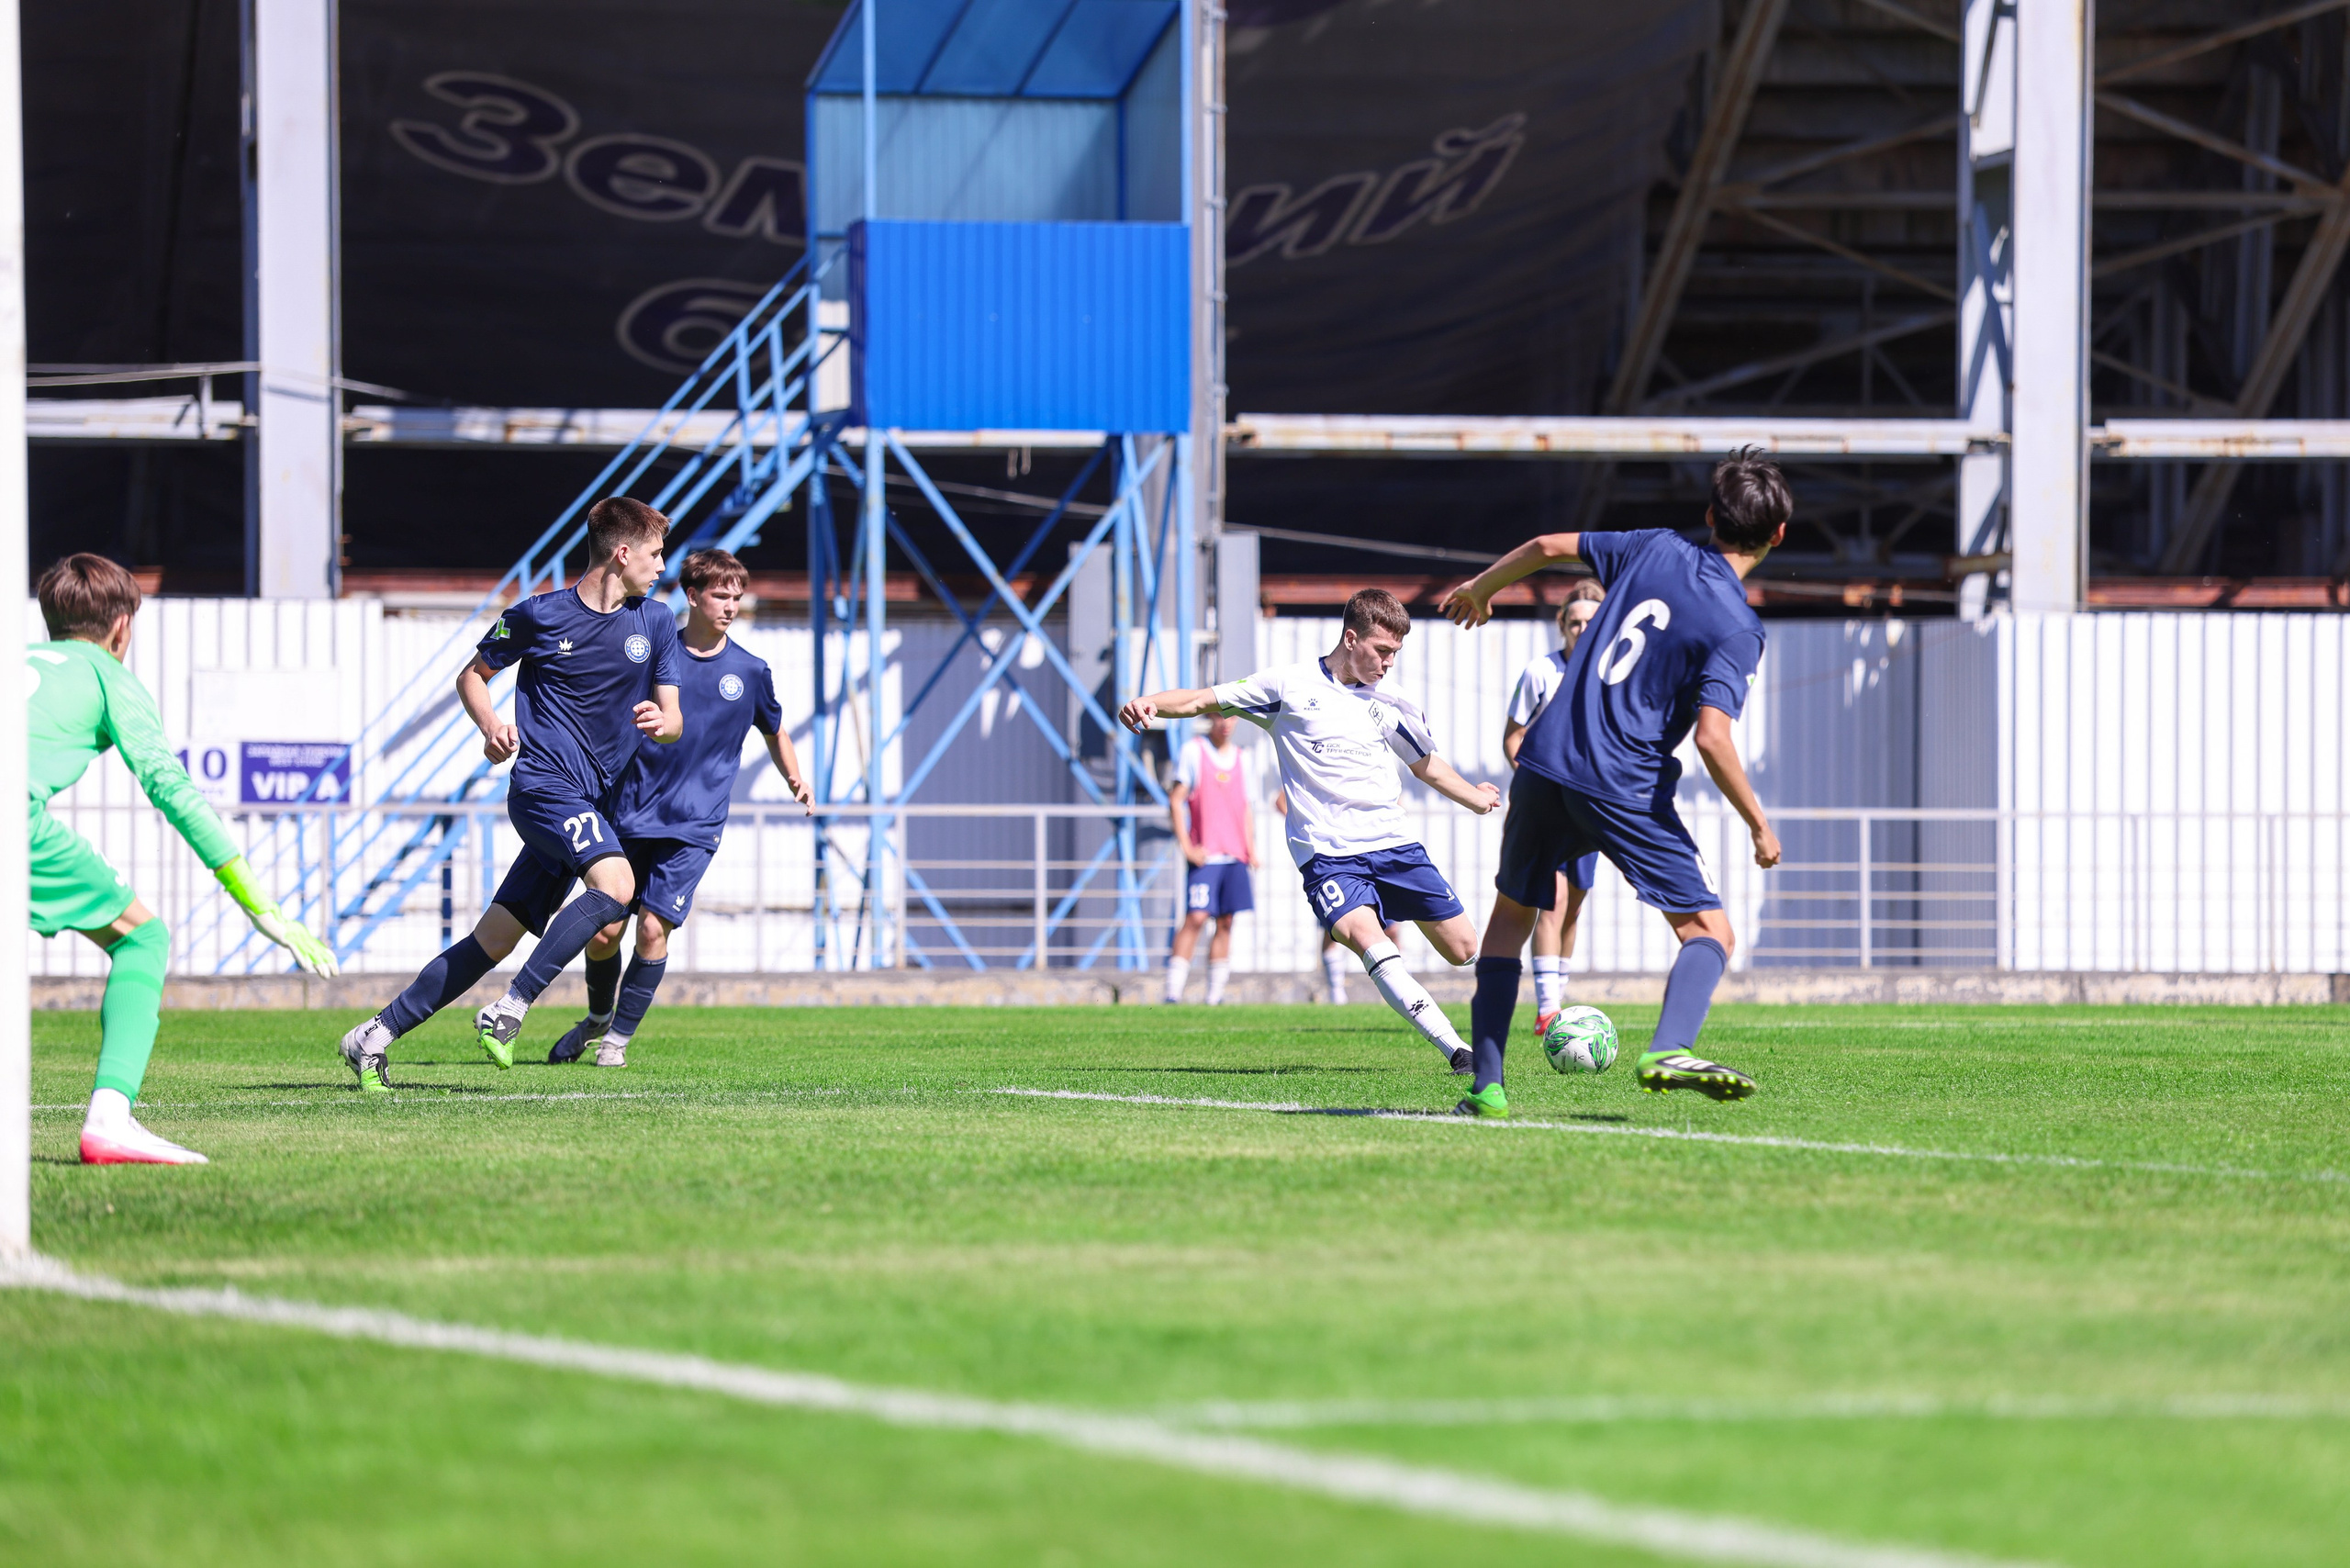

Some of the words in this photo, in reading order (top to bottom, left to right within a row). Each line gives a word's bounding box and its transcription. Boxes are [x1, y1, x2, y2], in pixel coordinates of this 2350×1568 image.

[1598, 599, 1671, 686] 6
[251, 771, 310, 801] VIP
[315, 772, 342, 801] A
[563, 812, 604, 853] 27
[1316, 879, 1346, 918] 19
